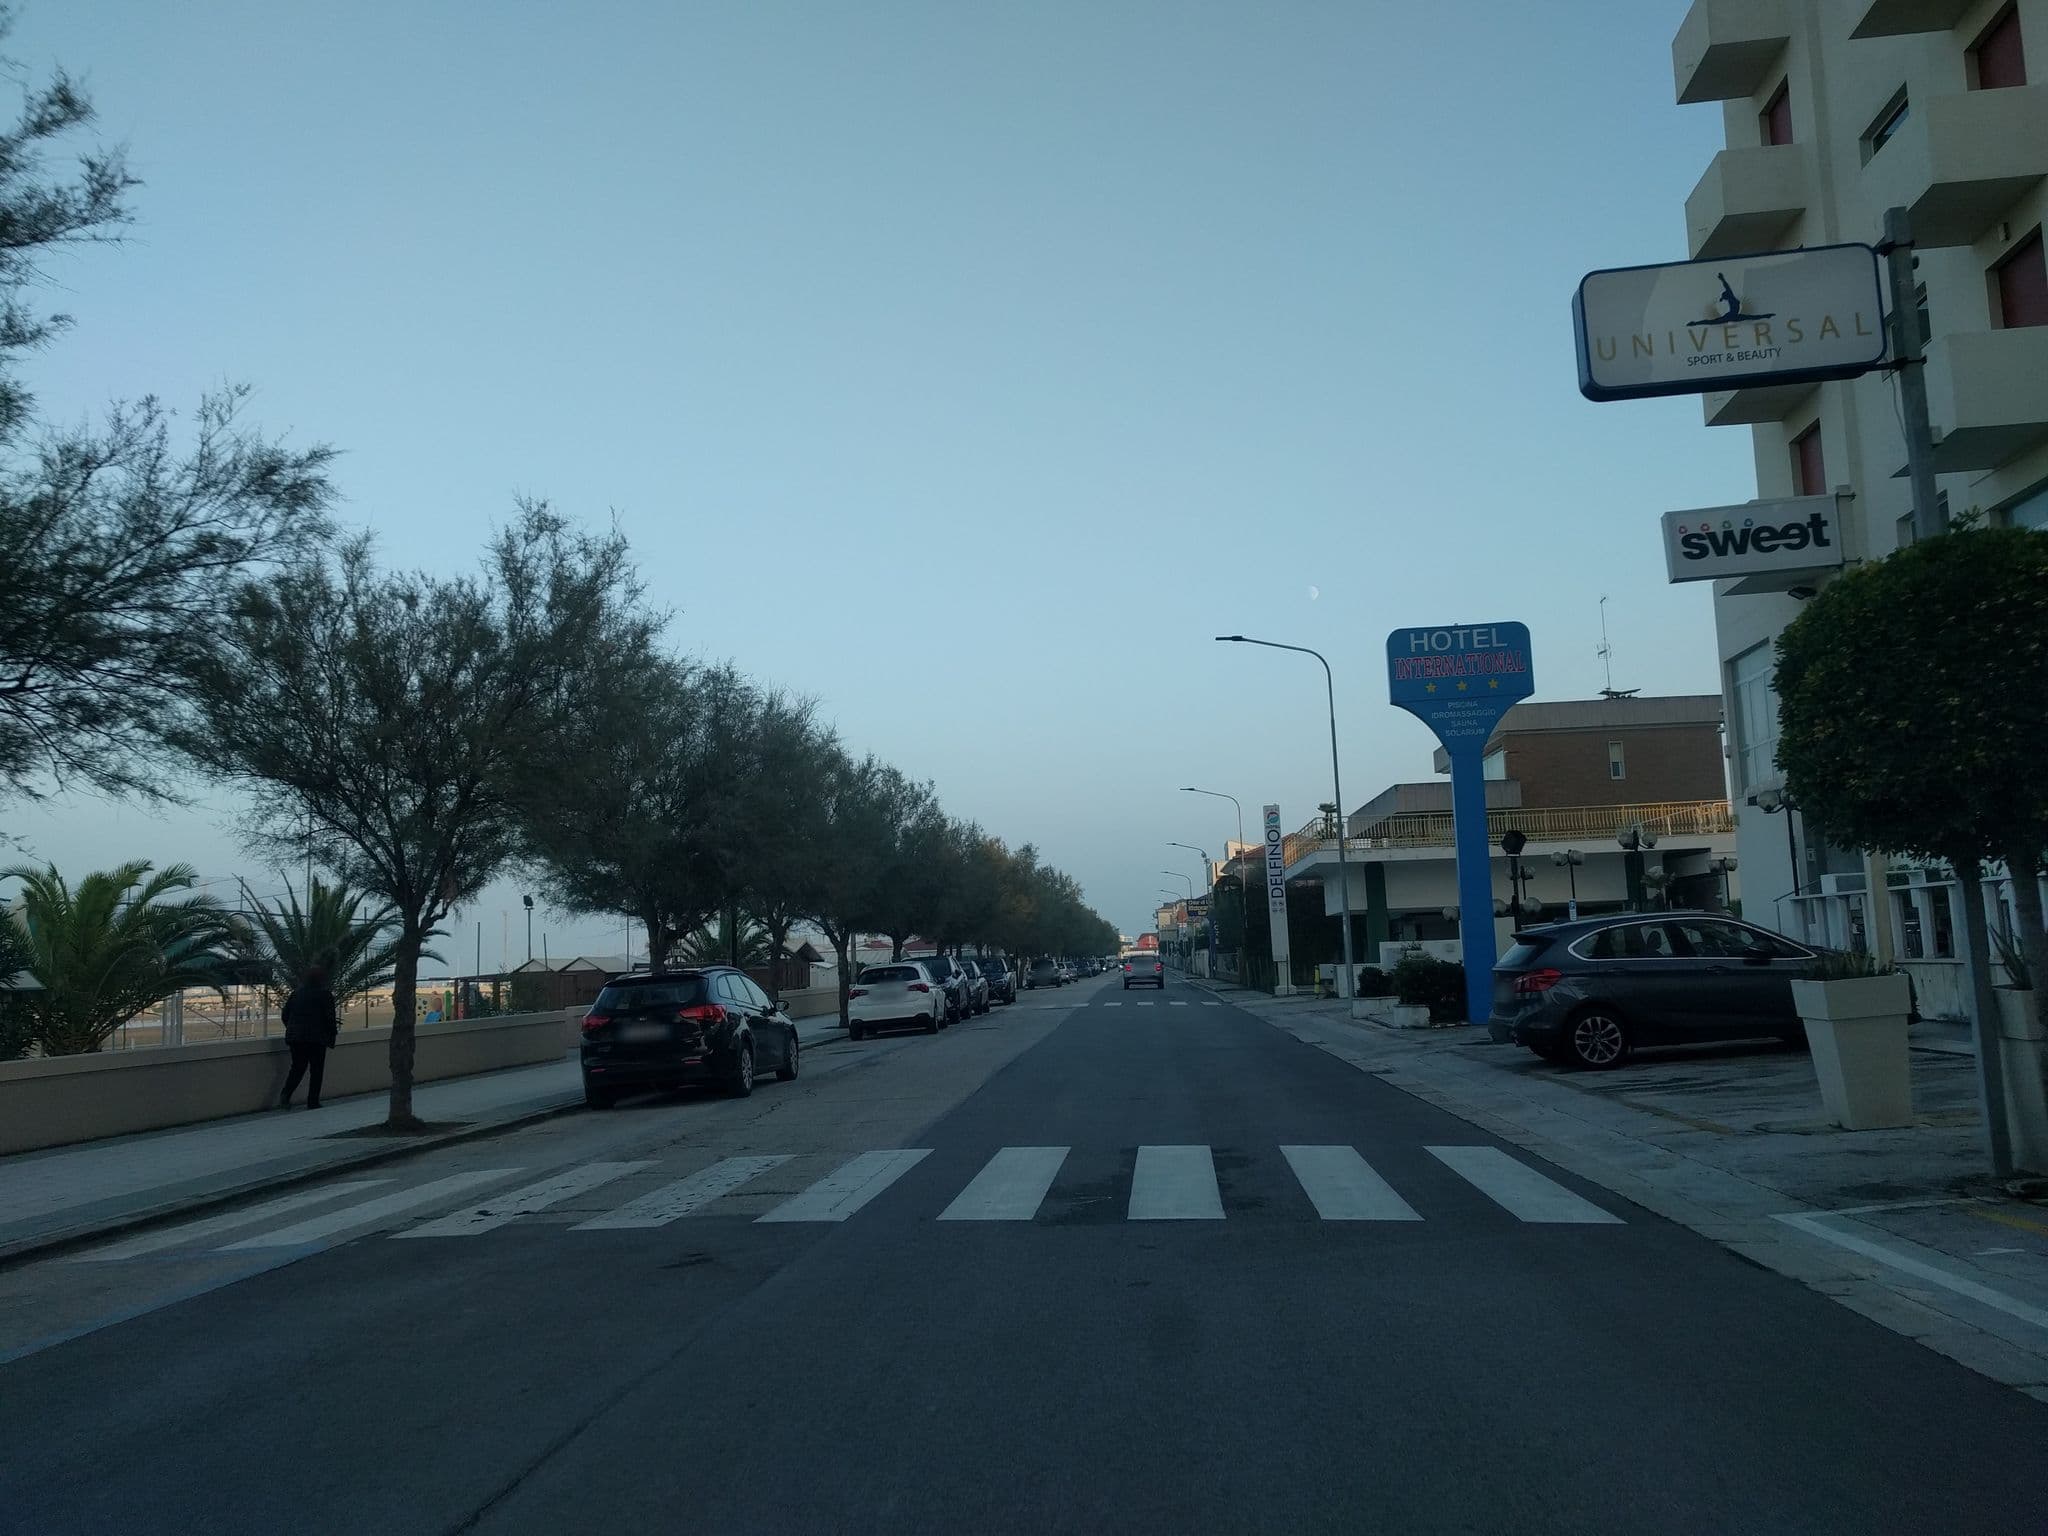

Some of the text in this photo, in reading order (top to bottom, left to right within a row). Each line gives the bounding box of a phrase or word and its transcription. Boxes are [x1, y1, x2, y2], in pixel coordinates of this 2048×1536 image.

[1596, 312, 1873, 361] UNIVERSAL
[1687, 347, 1782, 367] SPORT & BEAUTY
[1680, 512, 1831, 560] sweet
[1409, 627, 1508, 653] HOTEL
[1394, 651, 1526, 680] INTERNATIONAL
[1431, 709, 1496, 719] IDROMASSAGGIO
[1267, 829, 1284, 899] DELFINO
